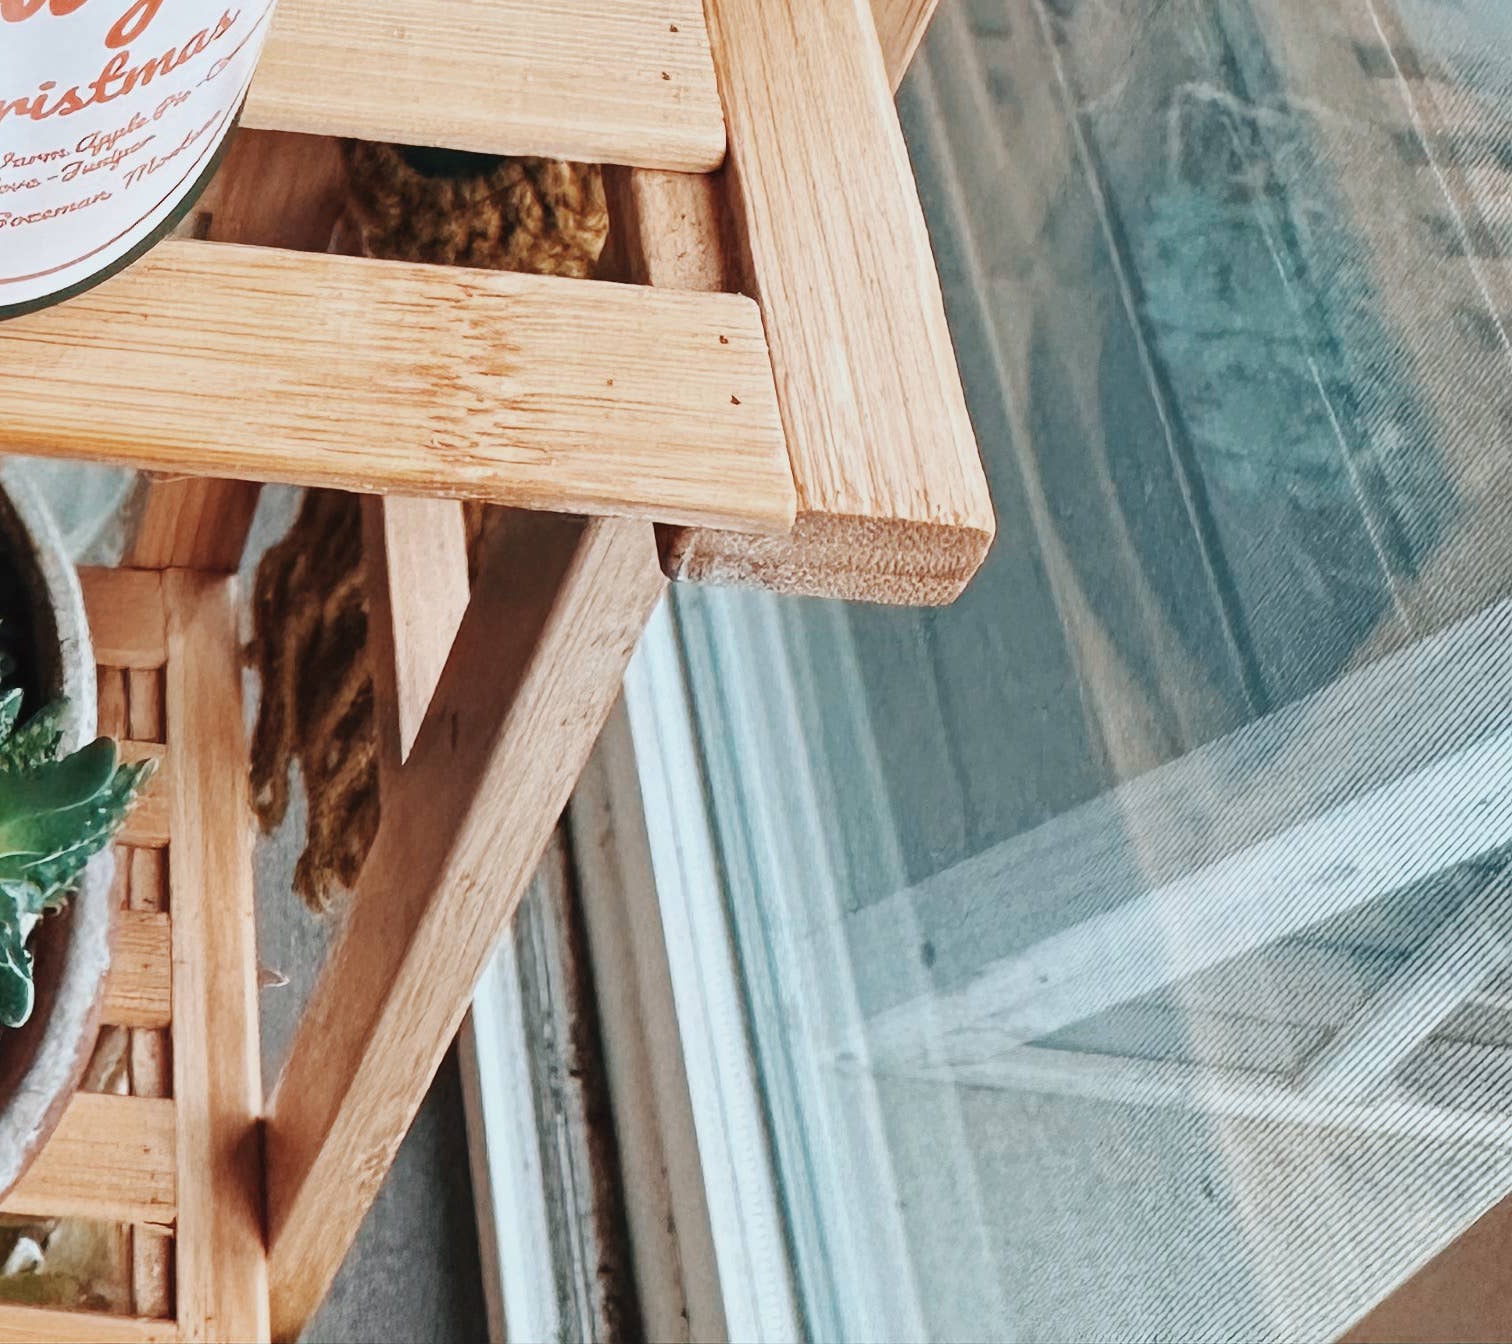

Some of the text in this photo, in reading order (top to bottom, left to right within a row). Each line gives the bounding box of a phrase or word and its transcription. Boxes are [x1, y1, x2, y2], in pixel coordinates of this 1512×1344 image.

[75, 111, 154, 154] Apple
[122, 109, 222, 190] Mont
[60, 134, 157, 184] Juniper
